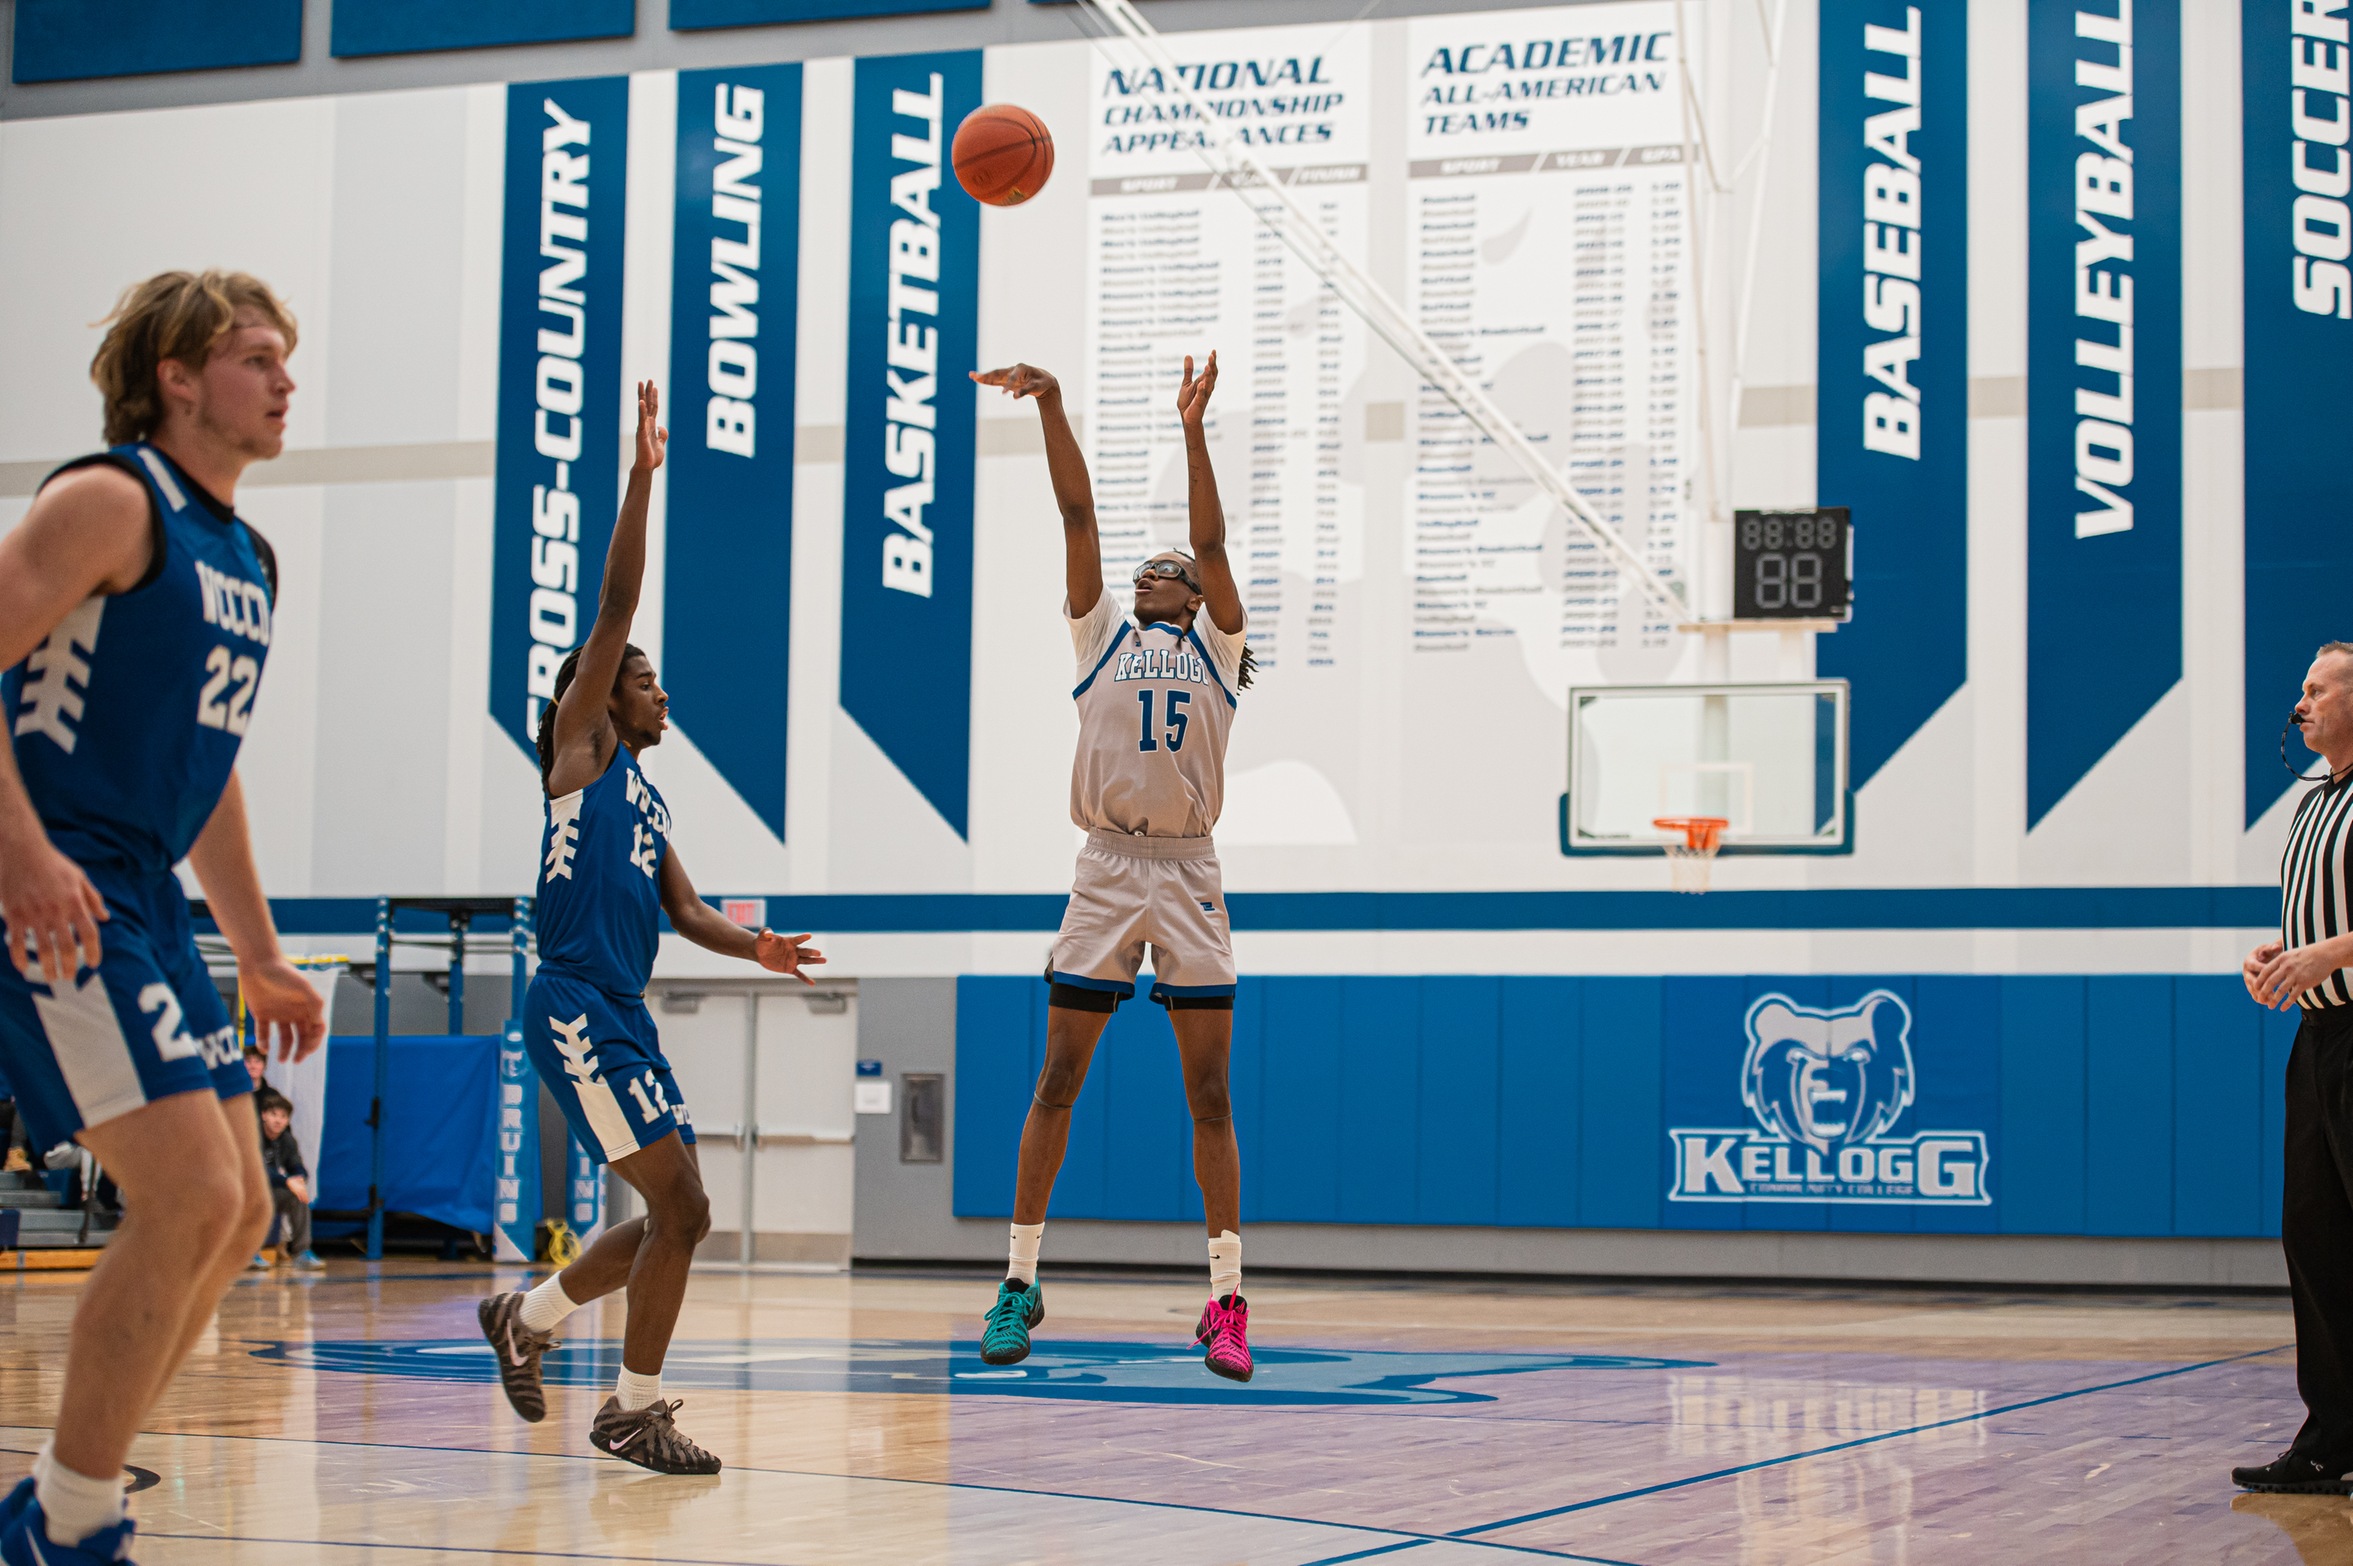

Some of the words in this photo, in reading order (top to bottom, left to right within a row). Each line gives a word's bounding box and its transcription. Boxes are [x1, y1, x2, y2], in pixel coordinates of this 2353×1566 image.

[1103, 55, 1332, 97] NATIONAL
[1420, 31, 1673, 78] ACADEMIC
[1420, 71, 1666, 108] ALL-AMERICAN
[1101, 122, 1333, 155] APPEAANCES
[1424, 109, 1532, 136] TEAMS
[2290, 0, 2353, 320] SOCCER
[1863, 6, 1921, 461] BASEBALL
[706, 82, 764, 459] BOWLING
[2075, 0, 2134, 539] VOLLEYBALL
[882, 72, 943, 598] BASKETBALL
[1755, 552, 1823, 609] 88
[196, 643, 259, 738] 22
[1137, 688, 1193, 754] 15
[627, 1068, 670, 1125] 12
[1683, 1136, 1977, 1198] KELLOGG
